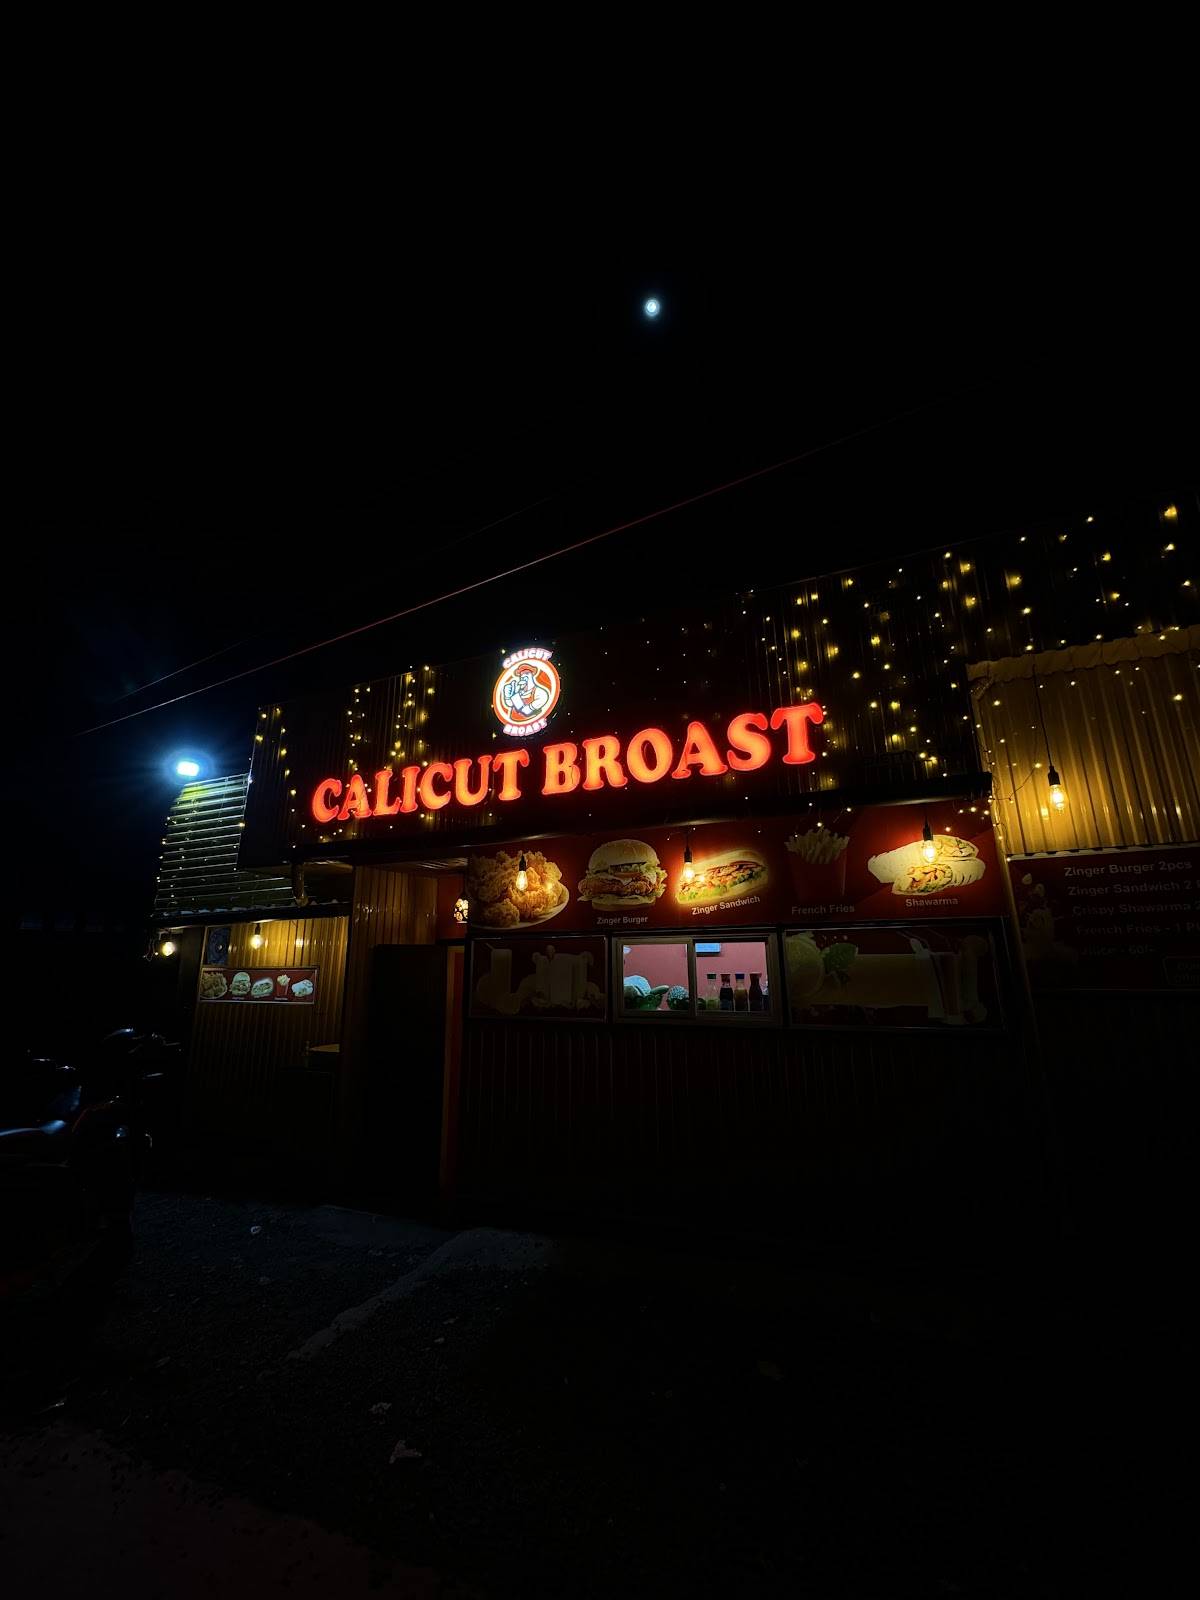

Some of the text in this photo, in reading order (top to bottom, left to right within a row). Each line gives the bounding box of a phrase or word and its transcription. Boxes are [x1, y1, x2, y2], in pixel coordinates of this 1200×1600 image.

[502, 648, 553, 669] CALICUT
[503, 718, 547, 737] BROAST
[312, 702, 824, 823] CALICUT BROAST
[1064, 860, 1193, 878] Zinger Burger 2pcs
[1067, 885, 1110, 896] Zinger
[1112, 881, 1181, 894] Sandwich
[1183, 880, 1193, 890] 2
[691, 896, 761, 915] Zinger Sandwich
[791, 904, 856, 915] French Fries
[905, 897, 959, 908] Shawarma
[1072, 904, 1115, 916] Crispy
[1119, 903, 1191, 913] Shawarma
[596, 915, 648, 925] Zinger Burger
[1076, 924, 1122, 935] French
[1126, 924, 1161, 934] Fries
